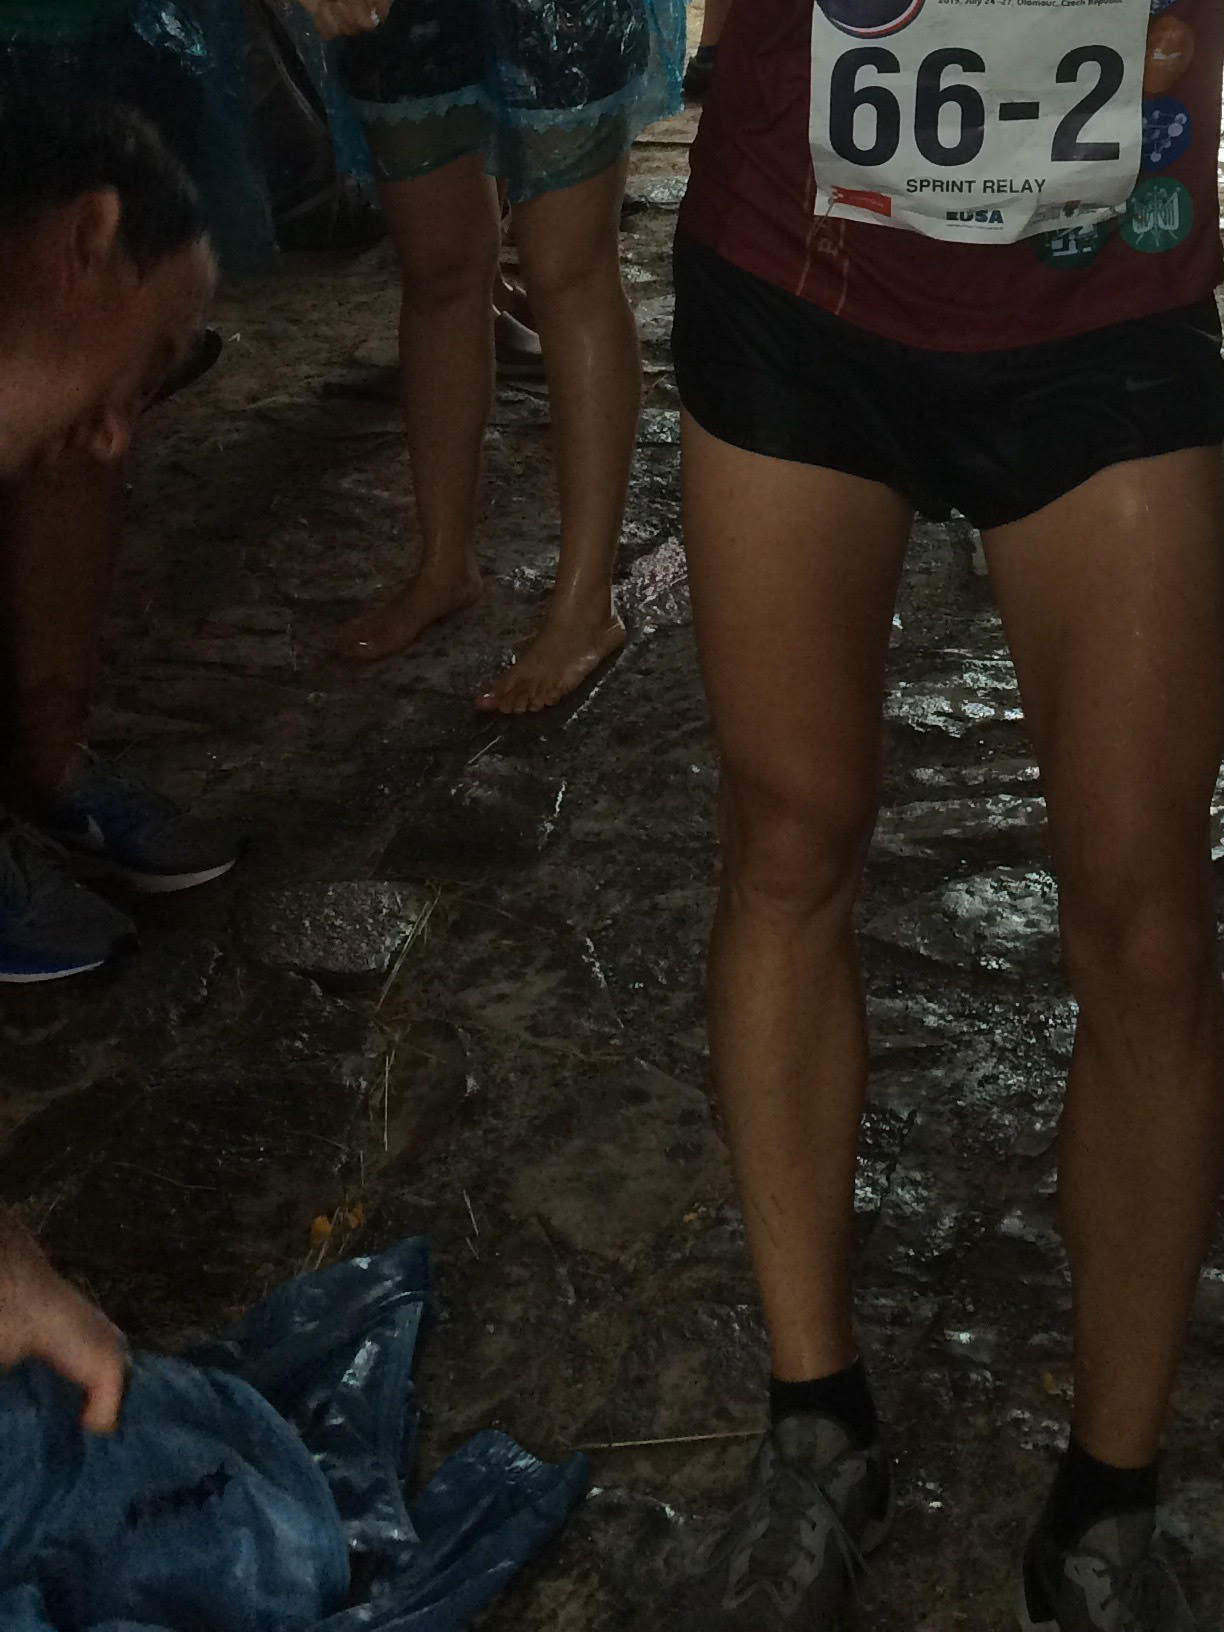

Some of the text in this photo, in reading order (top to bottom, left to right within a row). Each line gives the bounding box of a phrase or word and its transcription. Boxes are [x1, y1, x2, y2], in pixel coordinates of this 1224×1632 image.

[828, 44, 1125, 167] 66-2
[906, 179, 1046, 194] SPRINT RELAY
